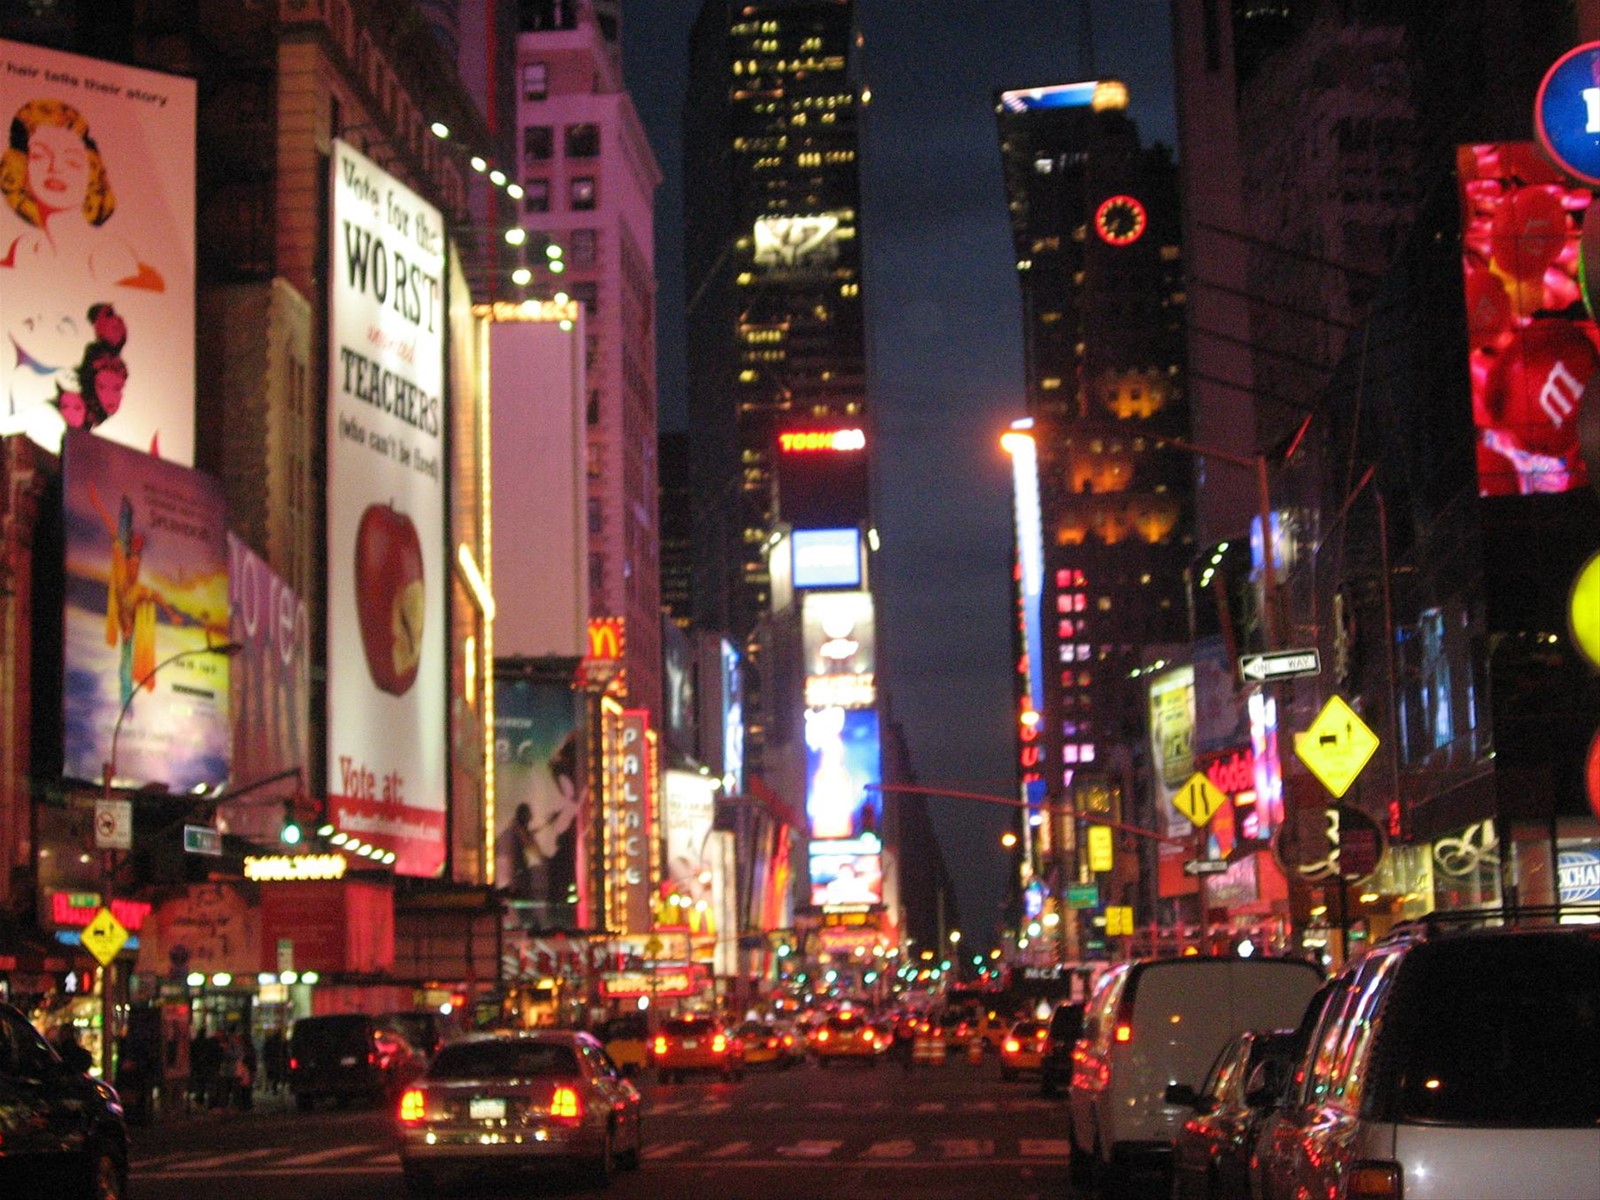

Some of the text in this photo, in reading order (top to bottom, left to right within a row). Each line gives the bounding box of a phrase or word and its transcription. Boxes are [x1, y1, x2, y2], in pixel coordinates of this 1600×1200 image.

[342, 157, 439, 256] Vote for the
[343, 220, 438, 334] WORST
[341, 345, 438, 438] TEACHERS
[1253, 657, 1311, 673] ONE WAY
[340, 756, 404, 804] Vote at:
[622, 727, 641, 886] PALACE
